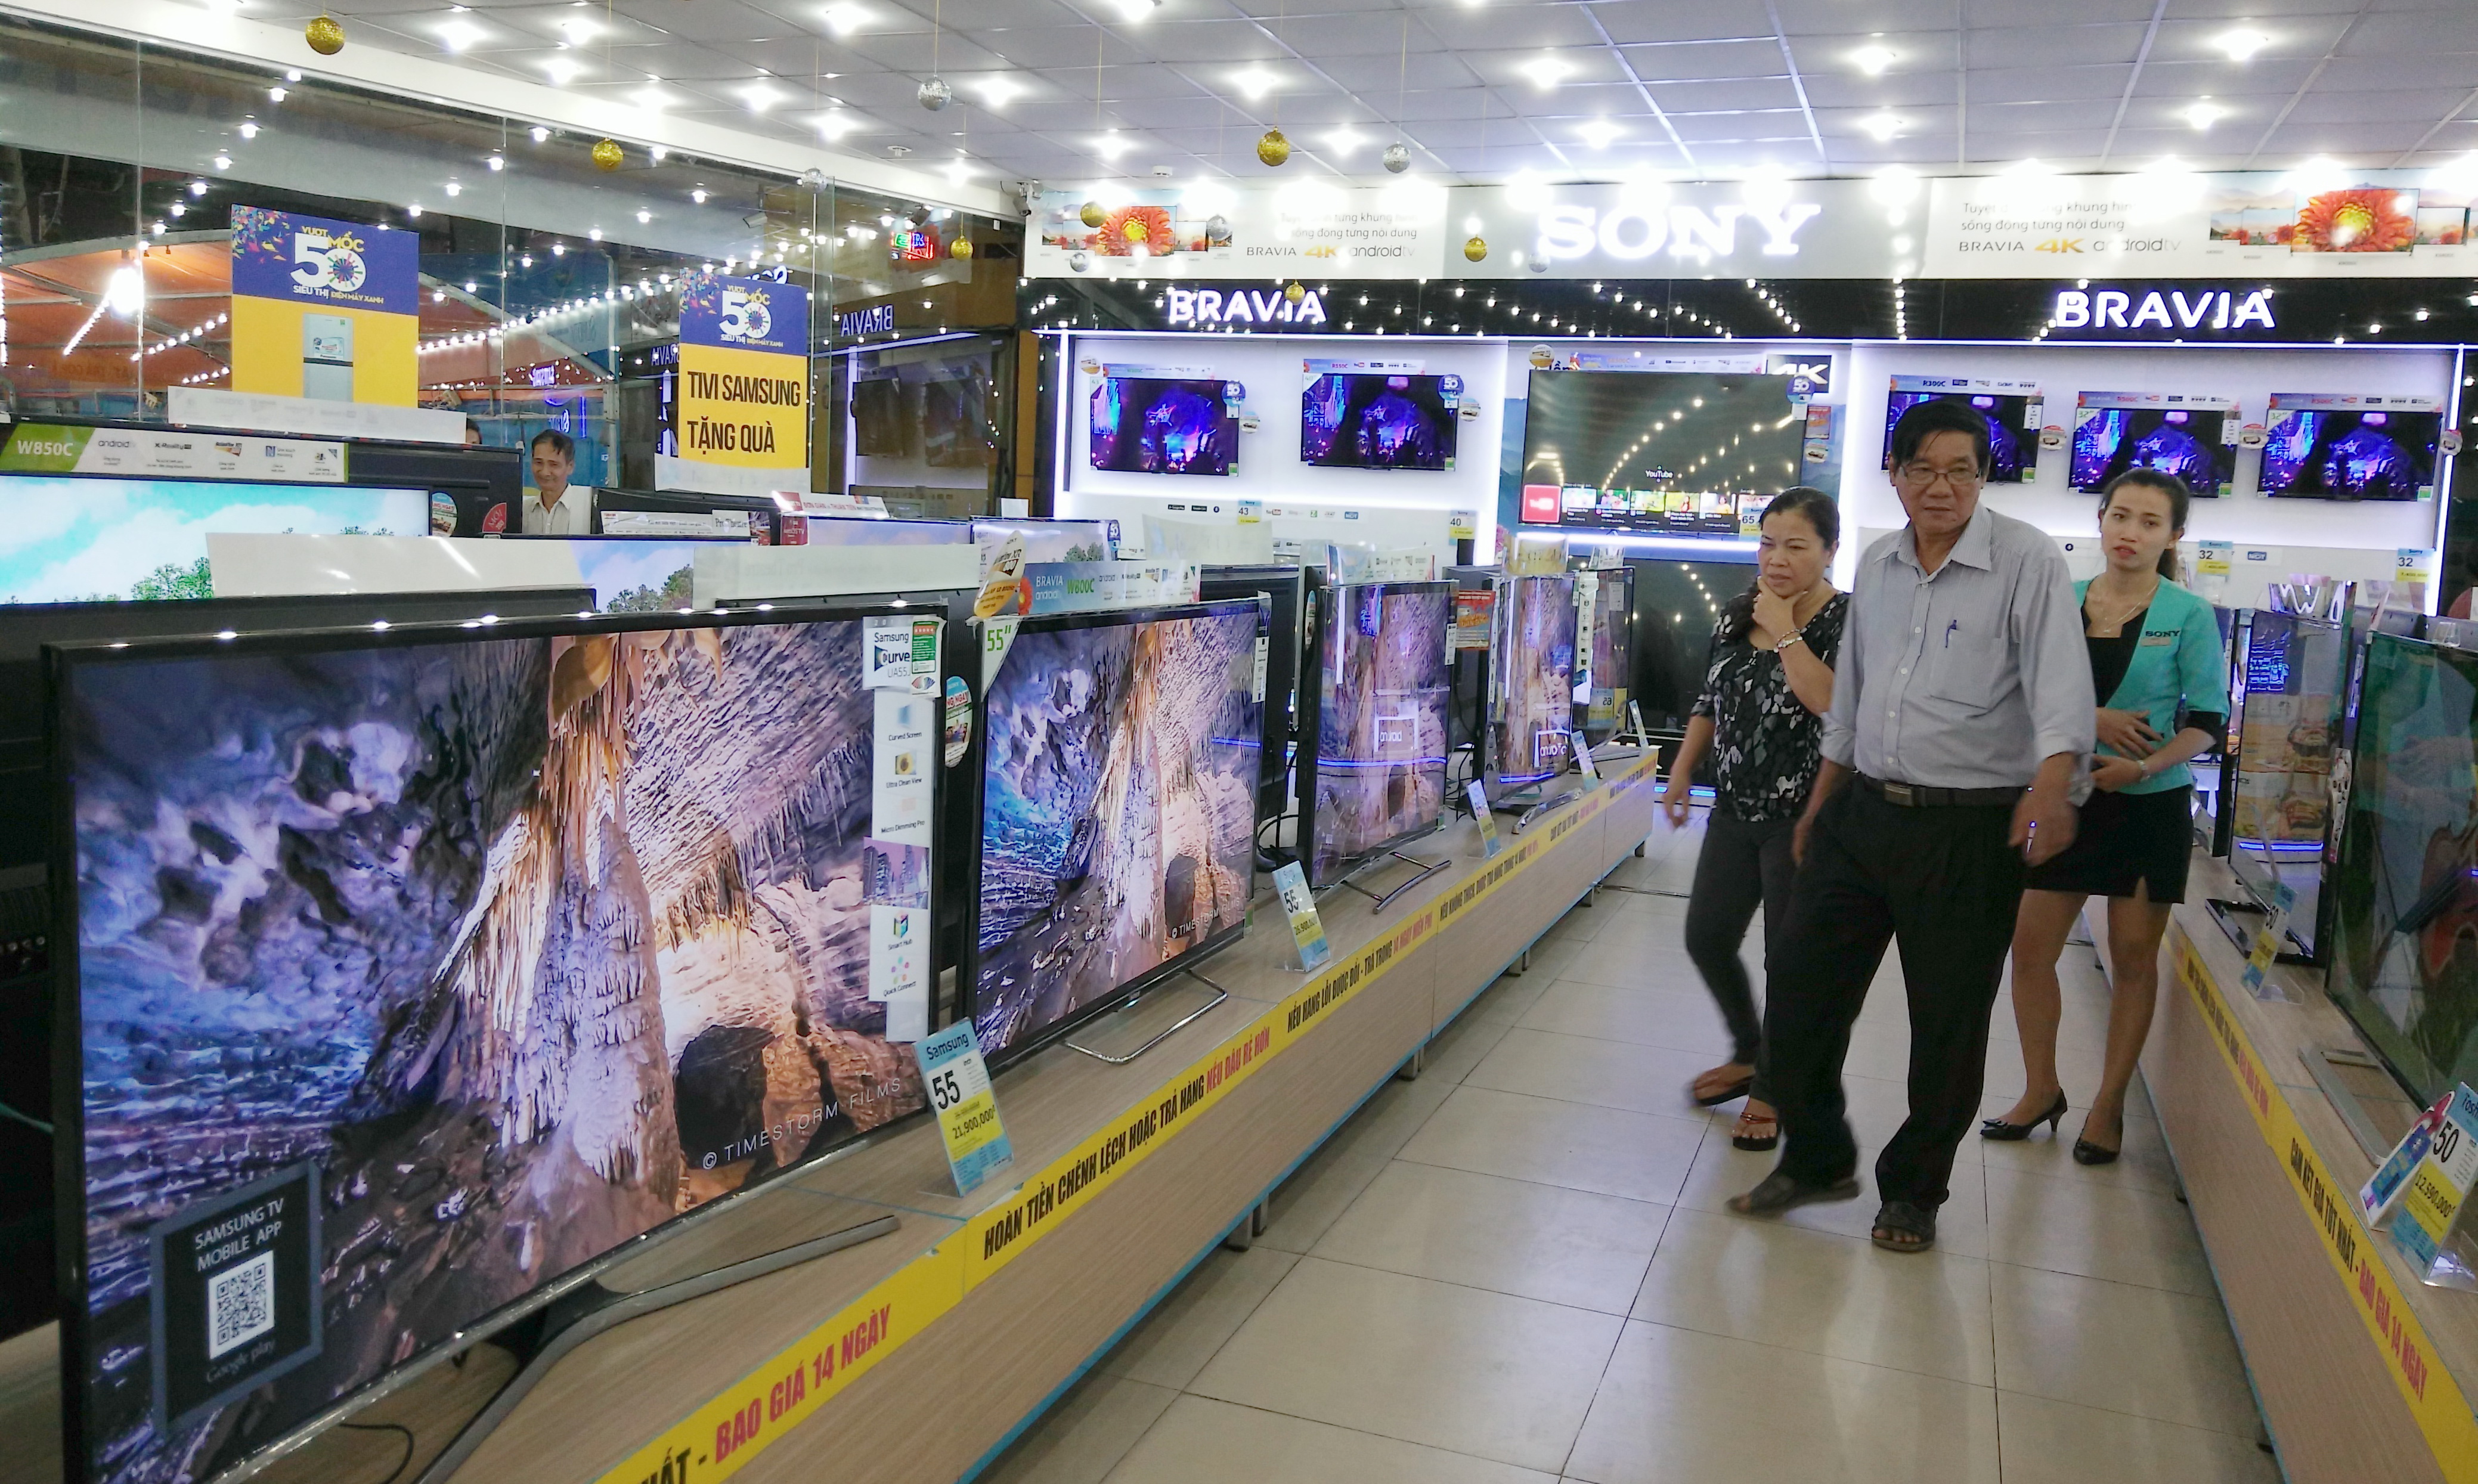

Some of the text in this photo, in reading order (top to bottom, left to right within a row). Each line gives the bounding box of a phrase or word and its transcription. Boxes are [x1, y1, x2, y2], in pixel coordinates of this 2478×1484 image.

[1538, 204, 1822, 259] SONY
[2090, 219, 2124, 232] dung
[1247, 247, 1297, 256] BRAVIA
[1304, 244, 1340, 258] 4K
[1959, 241, 2024, 252] BRAVIA
[2034, 238, 2085, 253] 4K
[290, 231, 367, 292] 50
[718, 290, 772, 339] 50
[1169, 289, 1327, 323] BRAVIA
[2056, 290, 2276, 329] BRAVIA
[687, 371, 801, 407] TIVI SAMSUNG
[17, 439, 73, 457] W850C
[687, 416, 776, 455] TẶNG QUÀ
[1646, 470, 1673, 479] YouTube
[1450, 518, 1462, 526] 40
[1742, 516, 1755, 525] 65
[2199, 550, 2213, 559] 32
[2398, 557, 2412, 567] 32
[1036, 575, 1063, 587] BRAVIA
[1067, 578, 1095, 594] W800C
[875, 632, 909, 643] Samsung
[987, 624, 1012, 652] 55"
[1179, 907, 1220, 936] TIMESTORM
[927, 1033, 969, 1060] Samsung
[932, 1070, 961, 1110] 55
[724, 1103, 839, 1161] TIMESTORM
[849, 1078, 902, 1108] FILMS
[2433, 1120, 2459, 1163] 50
[984, 1201, 1023, 1260] HOÀN
[1026, 1181, 1054, 1228] TIỀN
[1159, 1088, 1178, 1129] TRẢ
[1180, 1075, 1204, 1114] HÀNG
[194, 1198, 285, 1251] SAMSUNG TV
[197, 1220, 283, 1272] MOBILE APP
[715, 1398, 762, 1464] BAO
[769, 1359, 806, 1423] GIÁ
[812, 1343, 835, 1389] 14
[840, 1303, 891, 1371] NGÀY
